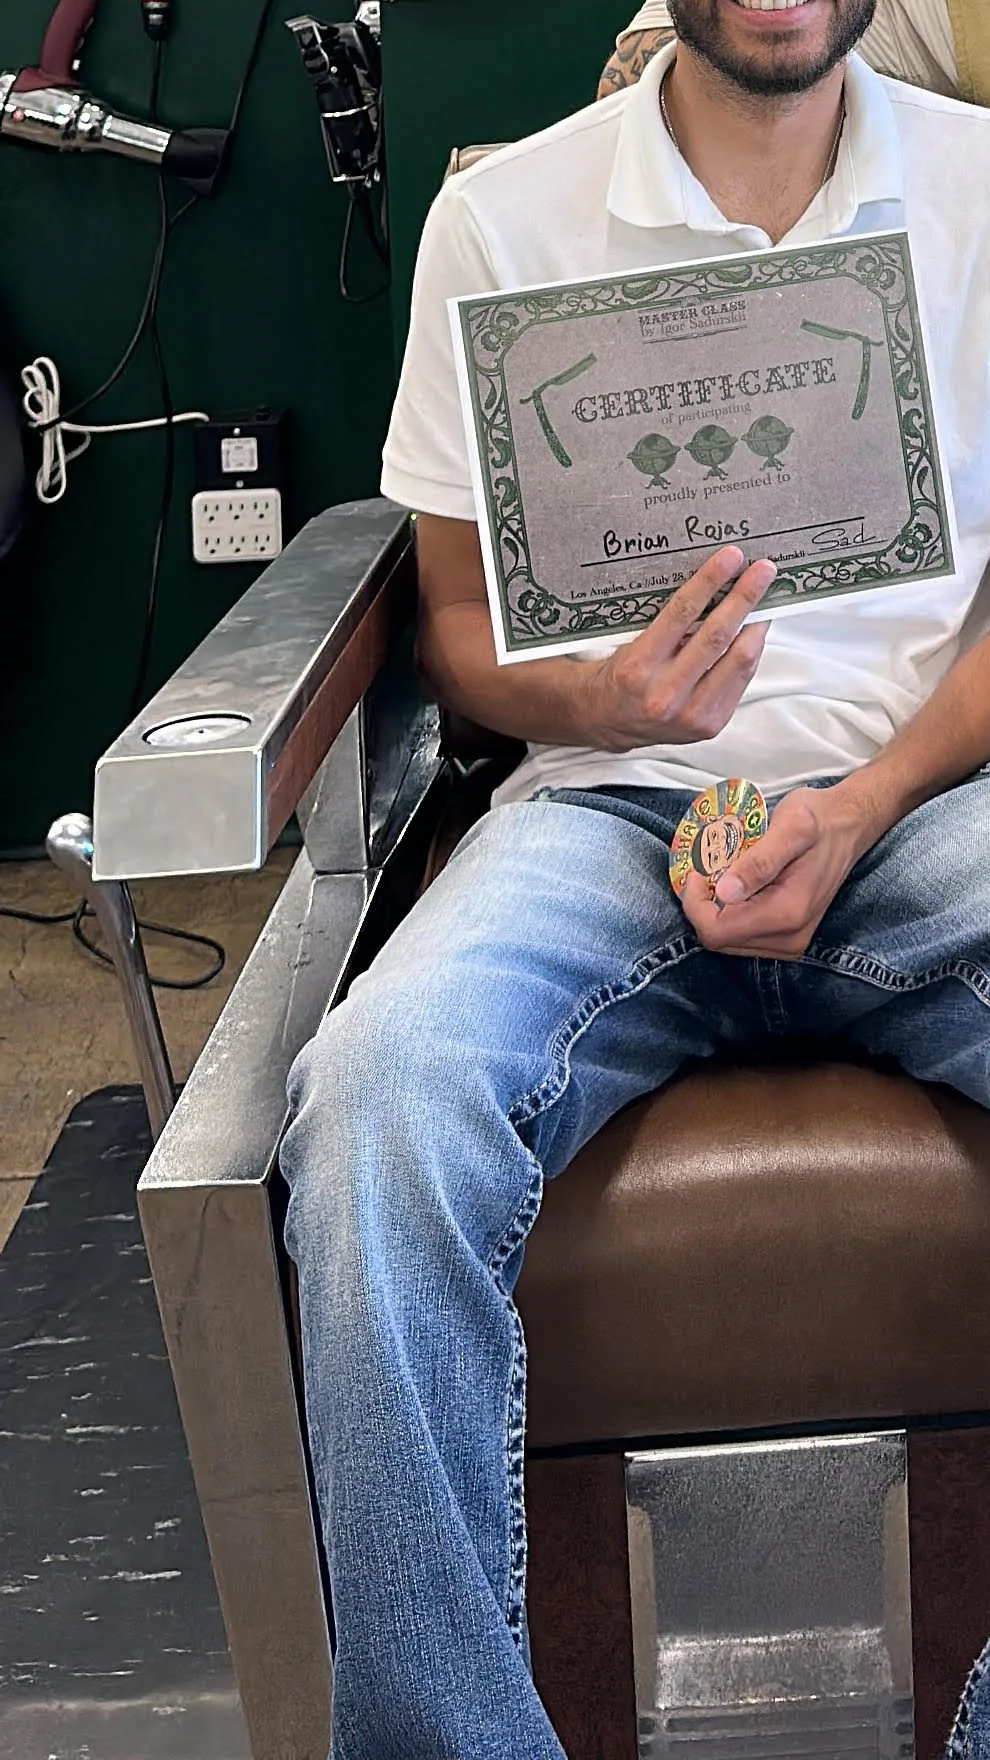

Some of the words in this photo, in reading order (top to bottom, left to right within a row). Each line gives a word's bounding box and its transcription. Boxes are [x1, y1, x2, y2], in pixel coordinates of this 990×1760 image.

[638, 307, 698, 326] MASTER
[700, 300, 746, 316] CLASS
[660, 321, 686, 336] Igor
[571, 357, 837, 424] CERTIFICATE
[660, 414, 673, 425] of
[678, 401, 752, 426] participating
[643, 485, 698, 509] proudly
[703, 474, 773, 500] presented
[777, 471, 791, 484] to
[602, 529, 669, 559] Brian
[685, 515, 751, 543] Rojas
[570, 589, 588, 600] Los
[589, 582, 627, 598] Angeles,
[629, 580, 642, 590] Ca
